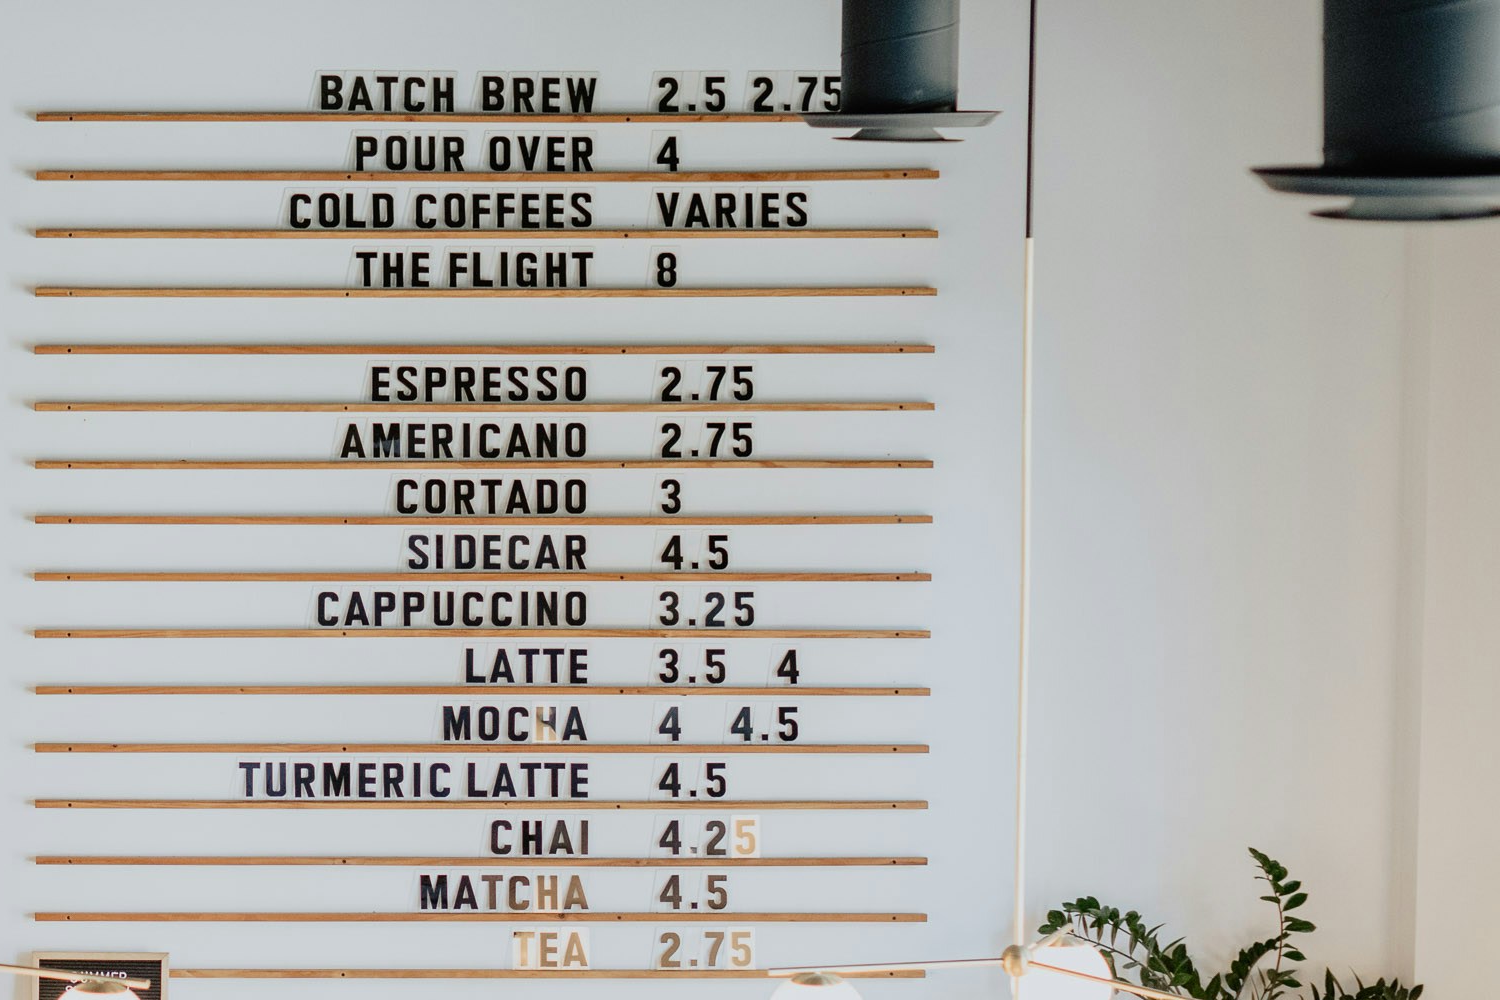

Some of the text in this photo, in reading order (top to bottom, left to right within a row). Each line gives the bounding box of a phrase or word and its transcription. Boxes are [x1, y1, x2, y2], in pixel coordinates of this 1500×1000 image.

[319, 76, 842, 112] BATCH BREW 2.5 2.75
[355, 136, 681, 172] POUR OVER 4
[289, 193, 809, 229] COLD COFFEES VARIES
[355, 252, 678, 288] THE FLIGHT 8
[371, 366, 753, 402] ESPRESSO 2.75
[341, 423, 752, 459] AMERICANO 2.75
[397, 479, 681, 515] CORTADO 3
[409, 535, 728, 570] SIDECAR 4.5
[318, 591, 754, 627] CAPPUCCINO 3.25
[466, 649, 799, 684] LATTE 3.5 4
[443, 706, 798, 741] MOCHA 4 4.5
[239, 762, 726, 798] TURMERIC LATTE 4.5
[491, 820, 756, 856] CHAI 4.25
[420, 875, 727, 910] MATCHA 4.5
[514, 931, 752, 968] TEA 2.75
